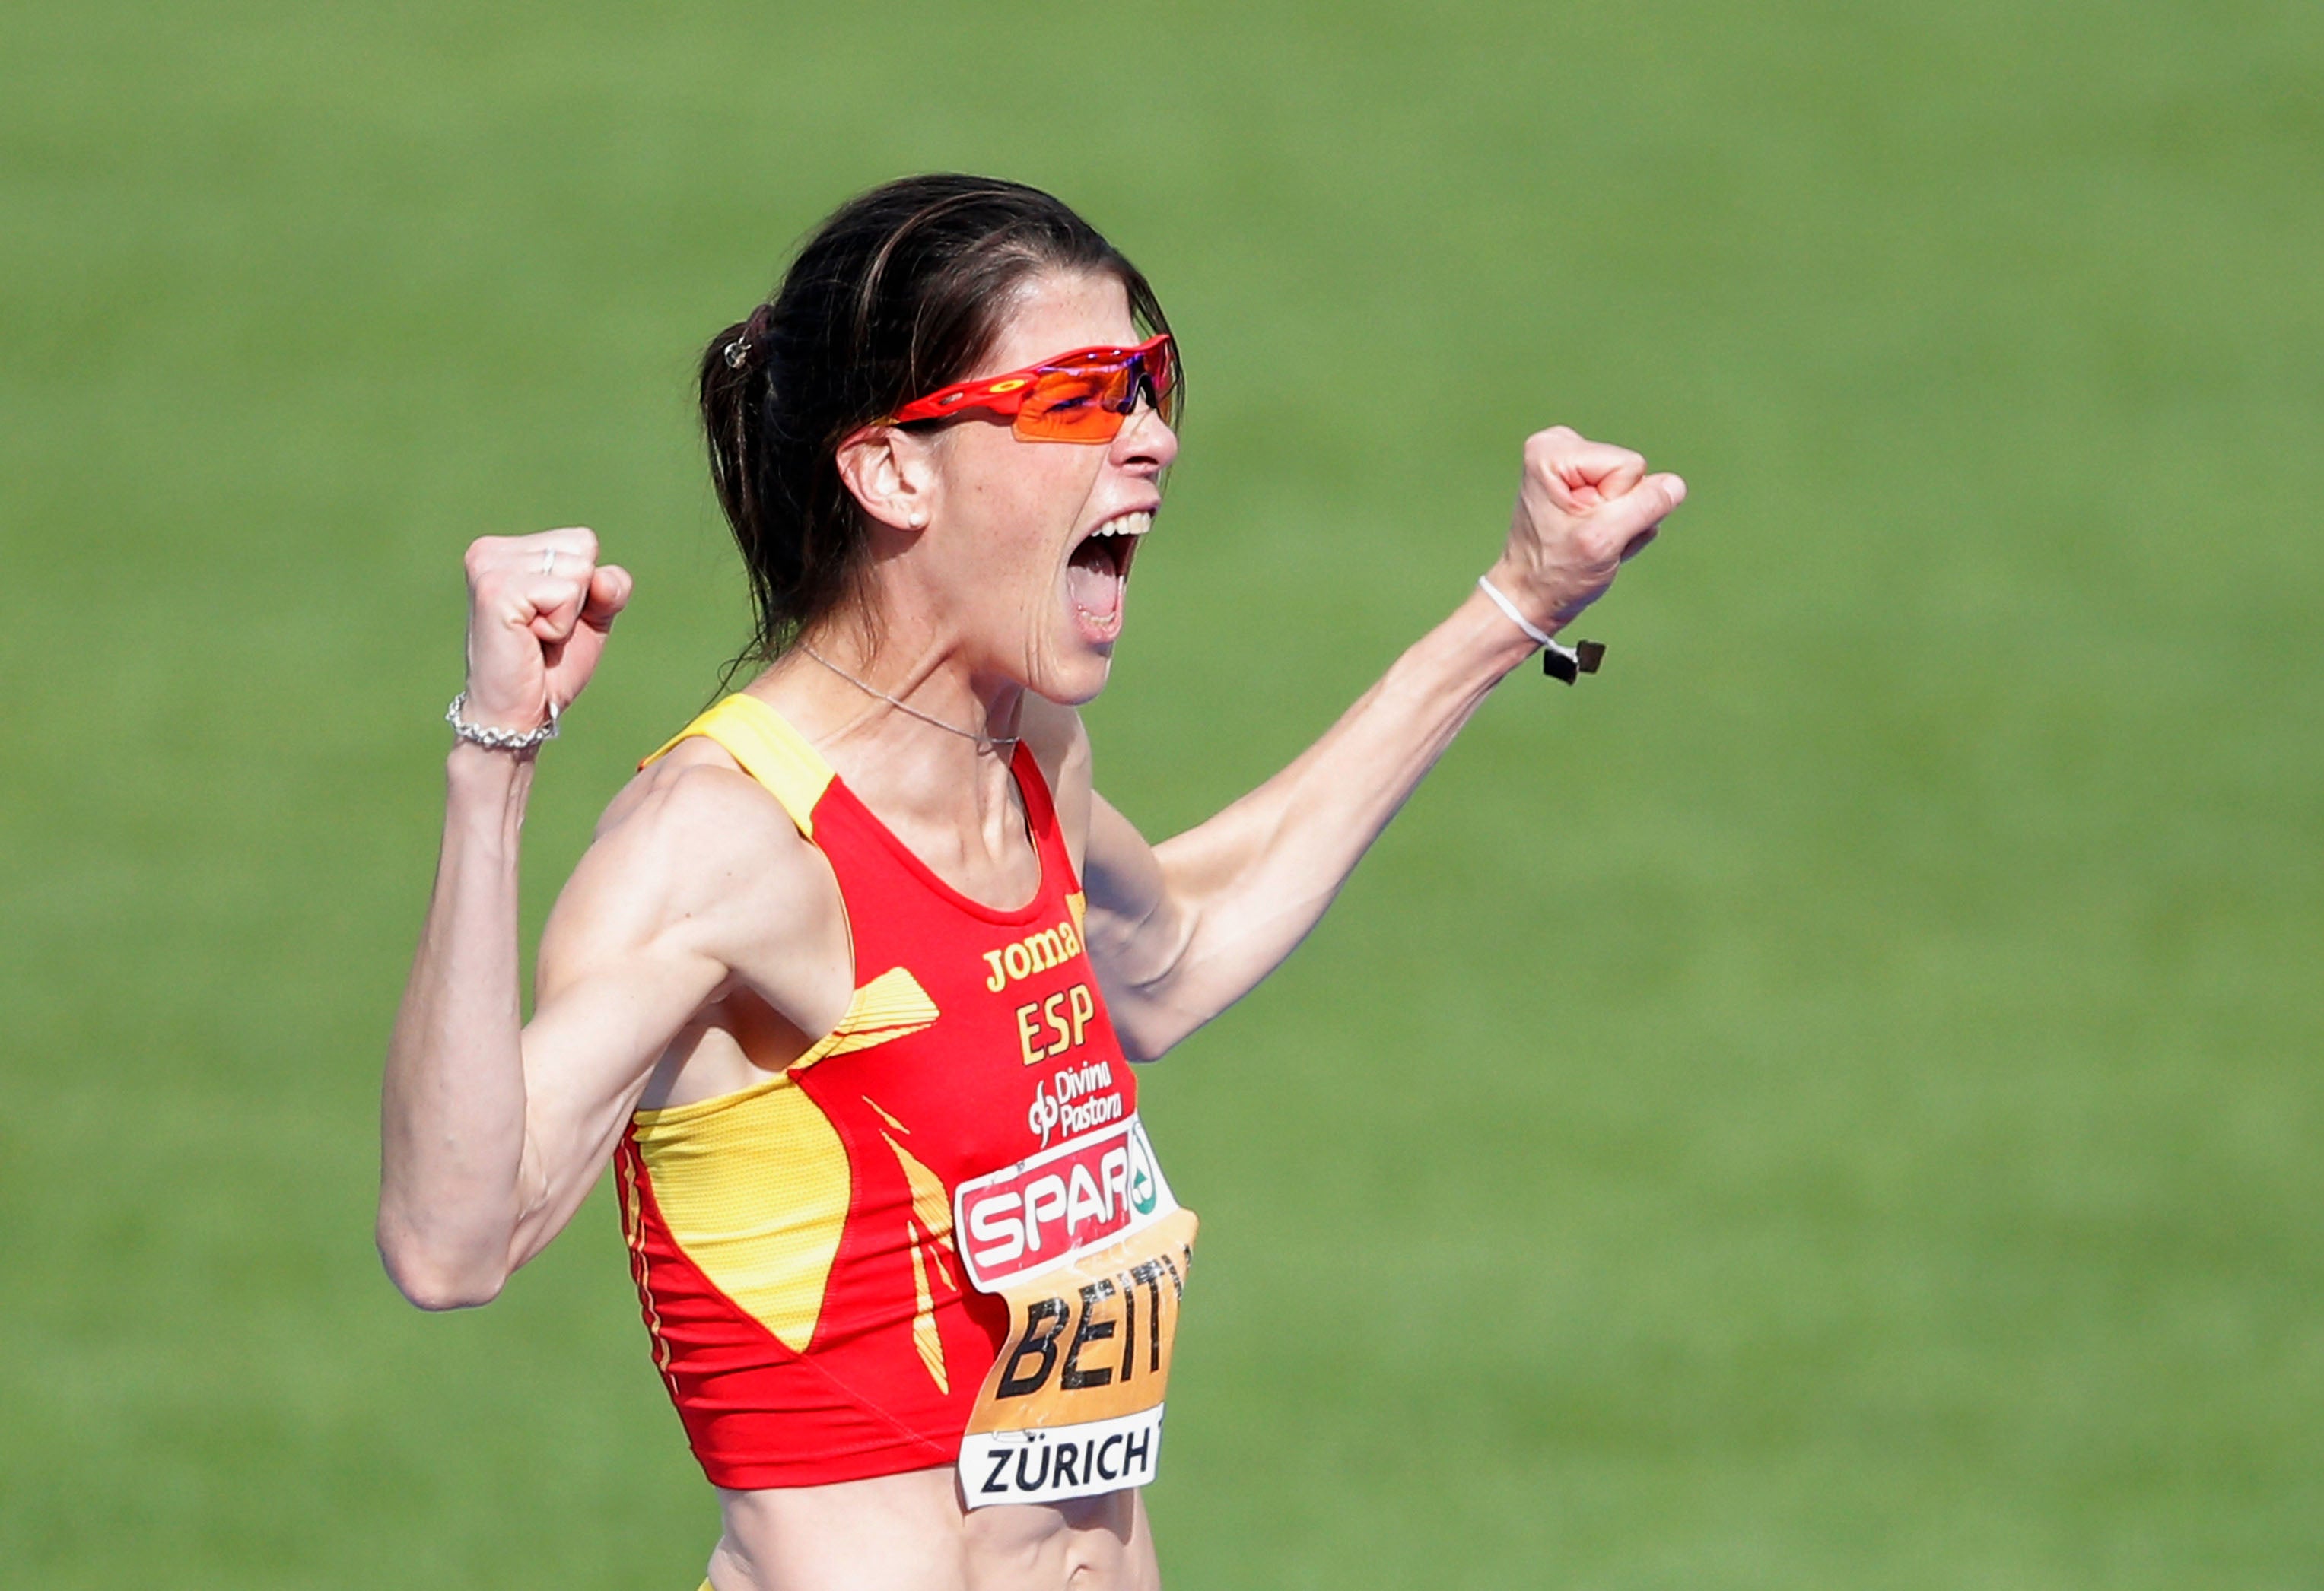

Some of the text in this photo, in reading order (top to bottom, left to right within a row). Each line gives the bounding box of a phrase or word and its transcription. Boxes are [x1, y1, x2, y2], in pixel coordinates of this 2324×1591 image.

[1016, 983, 1095, 1065] ESP
[1055, 1061, 1112, 1104] Divina
[1060, 1092, 1122, 1138] Pastora
[970, 1146, 1129, 1268] SPAR
[981, 1427, 1150, 1494] ZÜRICH
